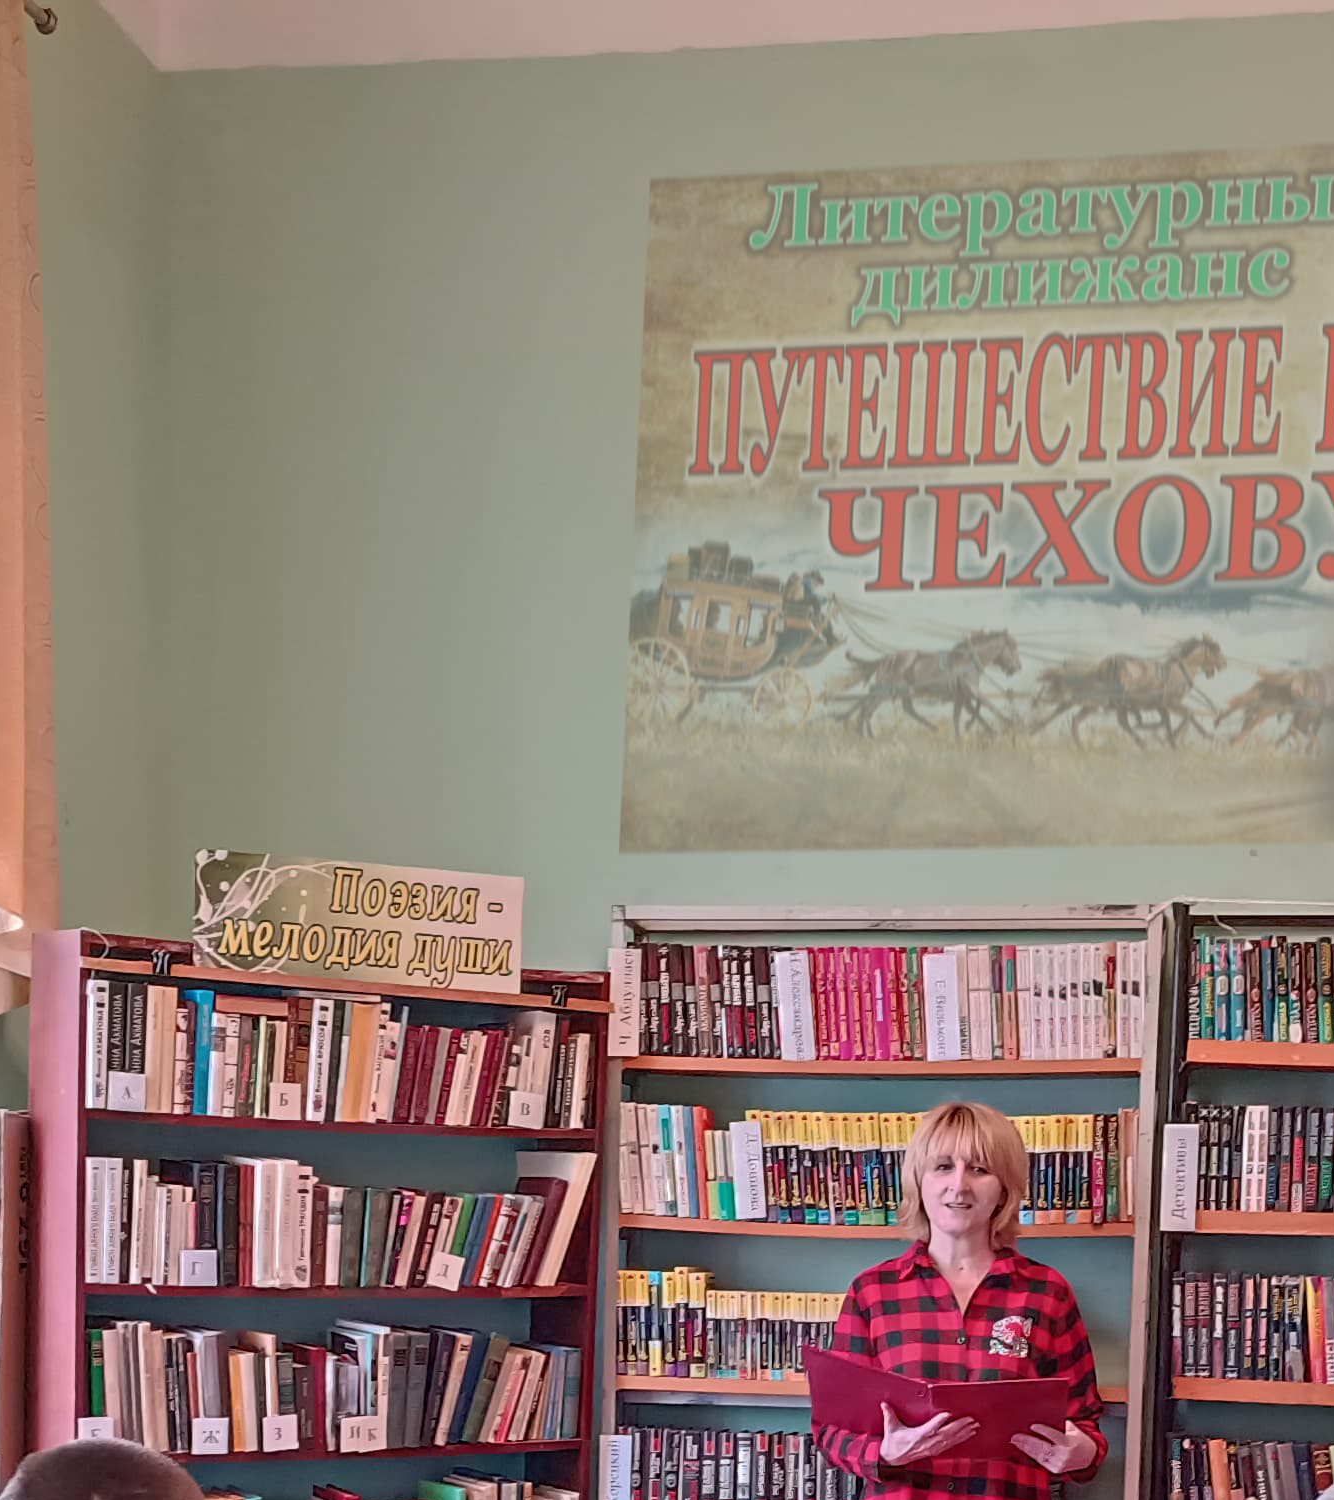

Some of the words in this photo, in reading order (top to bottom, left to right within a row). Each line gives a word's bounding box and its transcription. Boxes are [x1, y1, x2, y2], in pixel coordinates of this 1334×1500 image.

[850, 240, 1292, 325] дилижанс
[689, 323, 1284, 476] ПУТЕШЕСТВИЕ
[329, 866, 480, 925] Поэзия
[217, 917, 402, 970] мелодия
[407, 933, 512, 989] души
[110, 994, 123, 1046] АХМАТОВА
[130, 994, 144, 1046] АХМАТОВА
[122, 1087, 133, 1100] А
[279, 1093, 289, 1107] Б
[520, 1102, 531, 1115] В
[1170, 1137, 1188, 1219] Детективы
[202, 1430, 220, 1444] Ж
